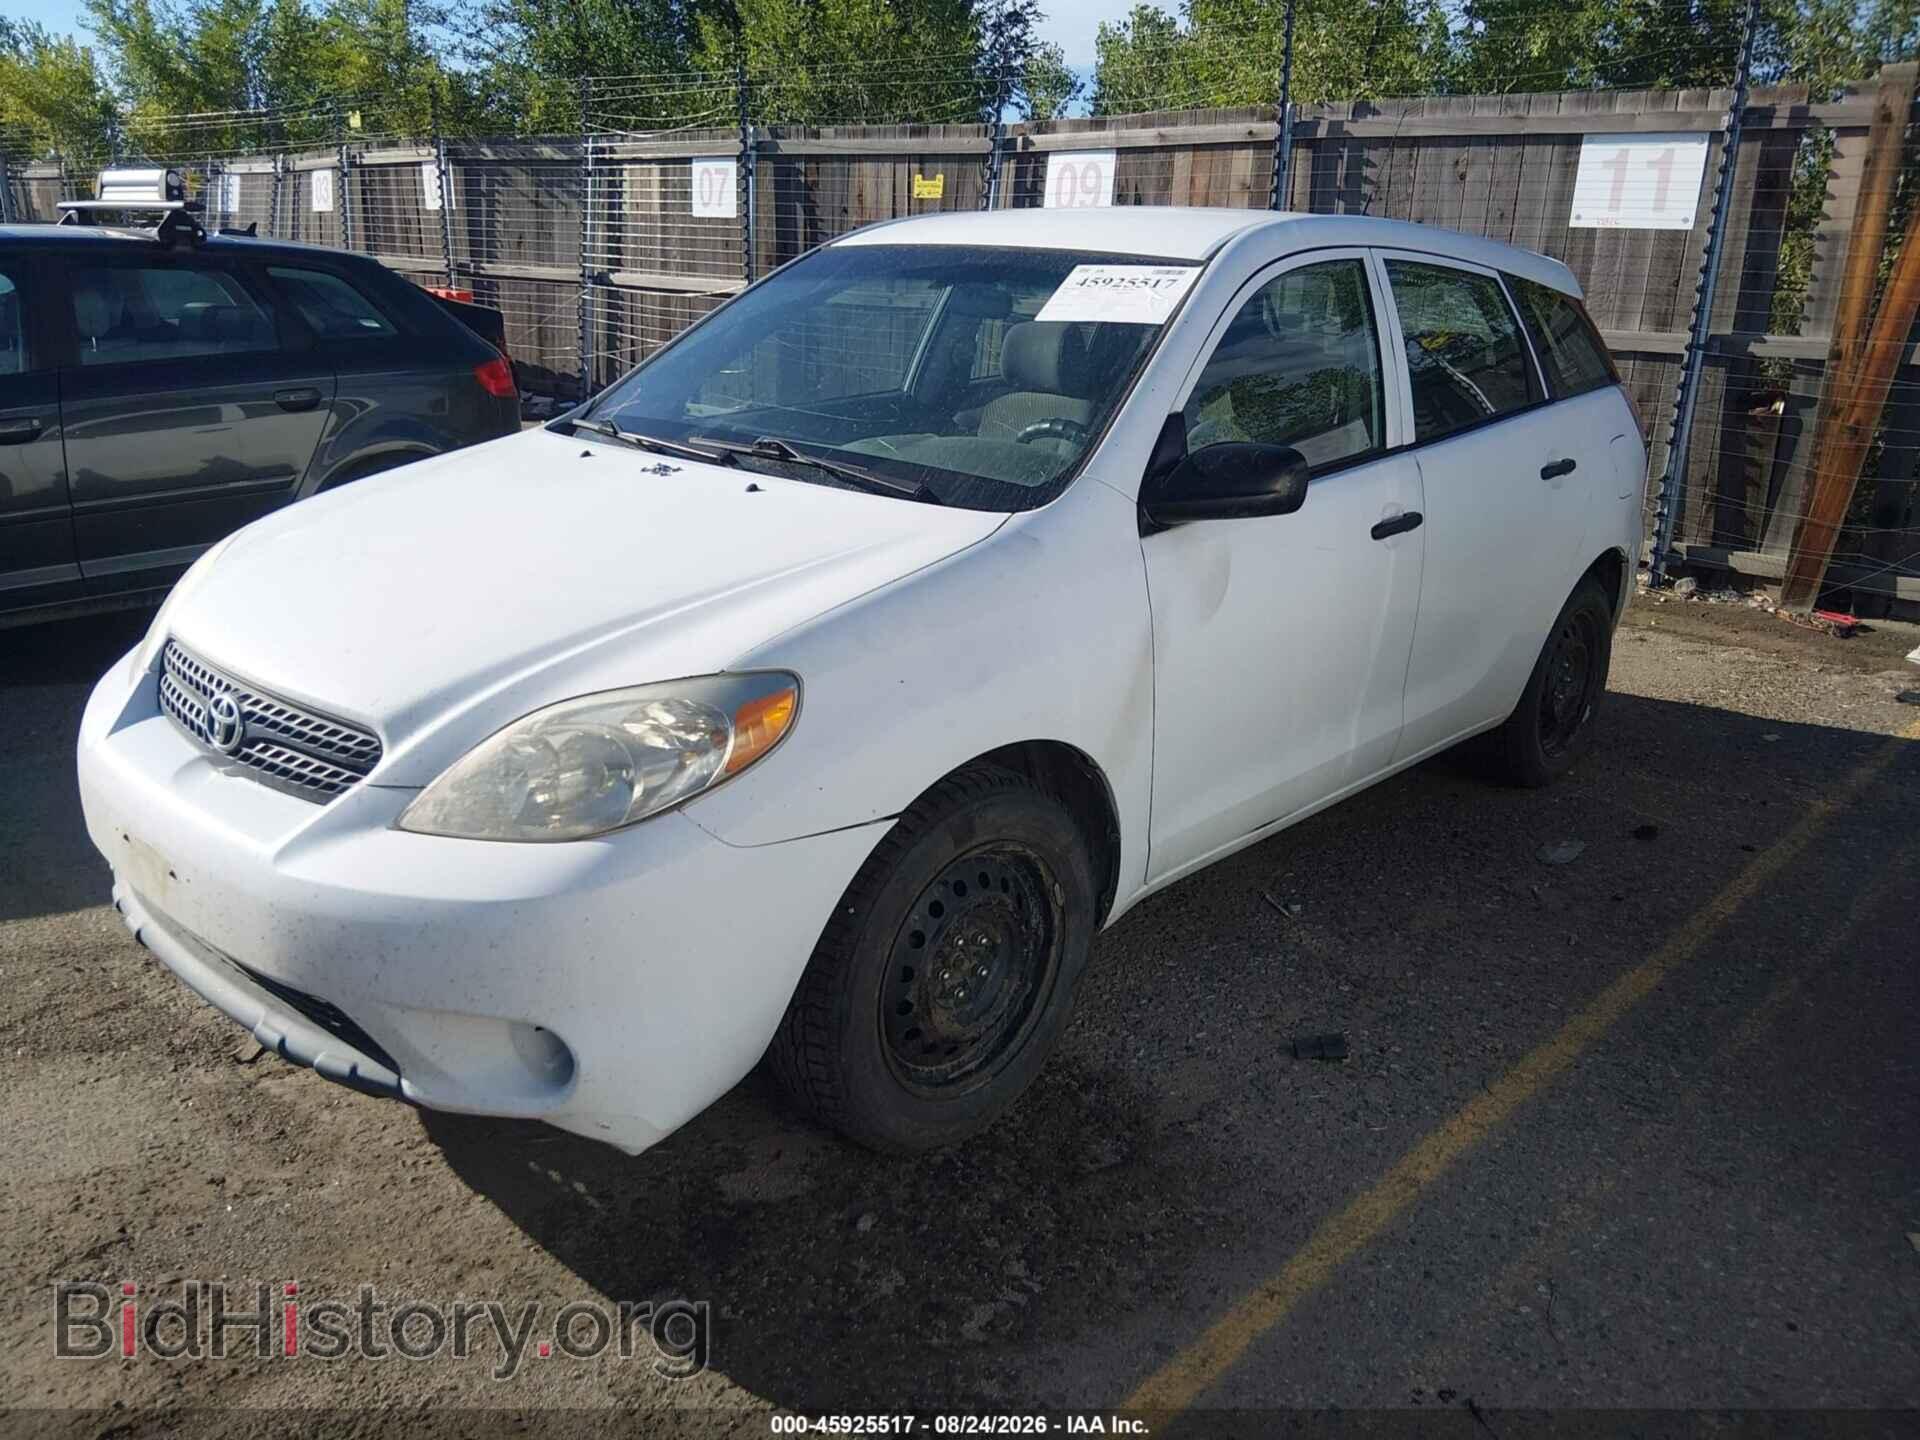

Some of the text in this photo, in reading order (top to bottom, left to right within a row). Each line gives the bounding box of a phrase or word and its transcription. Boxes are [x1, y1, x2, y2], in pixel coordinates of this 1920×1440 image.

[700, 167, 729, 207] 07
[1056, 161, 1102, 208] 09
[1601, 147, 1675, 212] 11
[1076, 276, 1178, 289] 45925517
